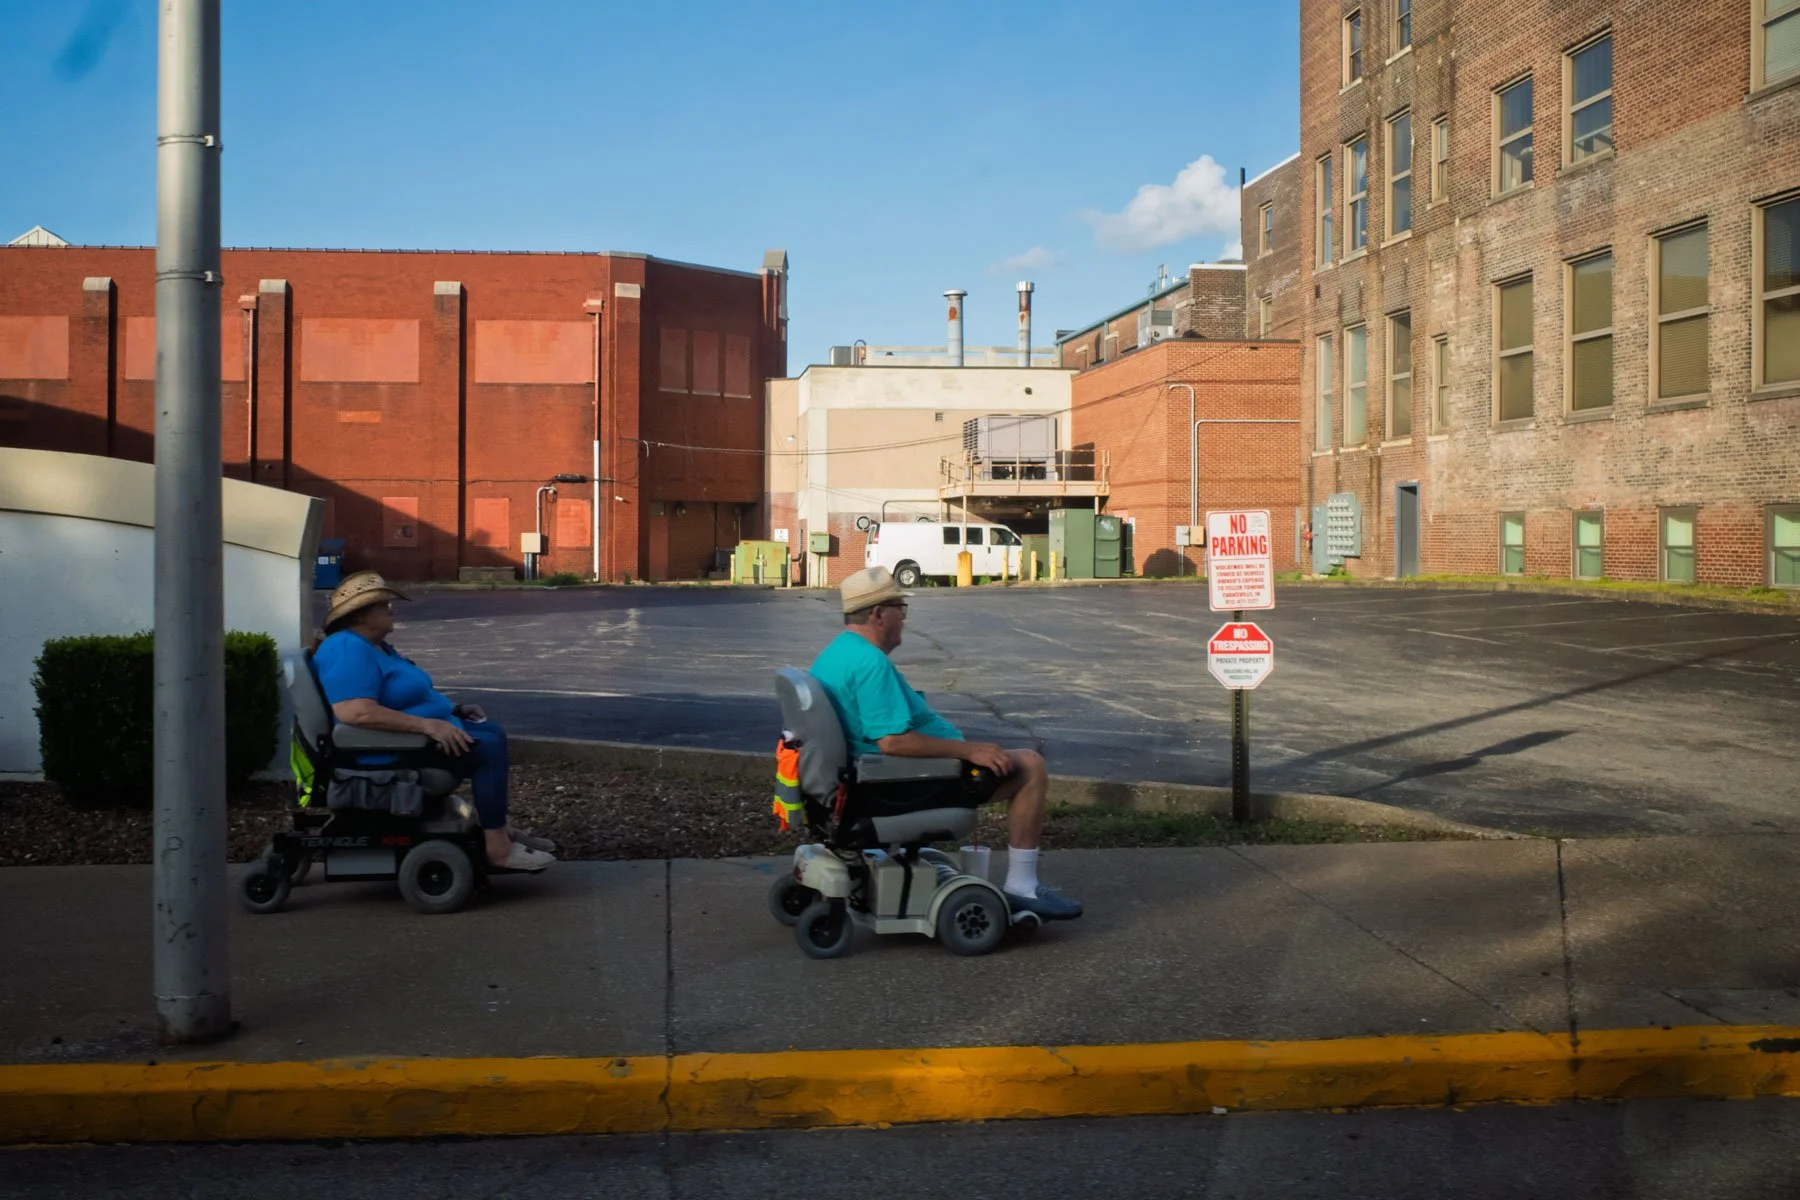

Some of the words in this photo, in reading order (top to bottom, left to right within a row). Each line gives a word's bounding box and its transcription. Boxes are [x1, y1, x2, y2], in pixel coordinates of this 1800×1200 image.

[1230, 514, 1247, 534] NO
[1212, 535, 1267, 556] PARKING
[1233, 628, 1248, 639] NO
[1213, 640, 1269, 652] TRESPASSING
